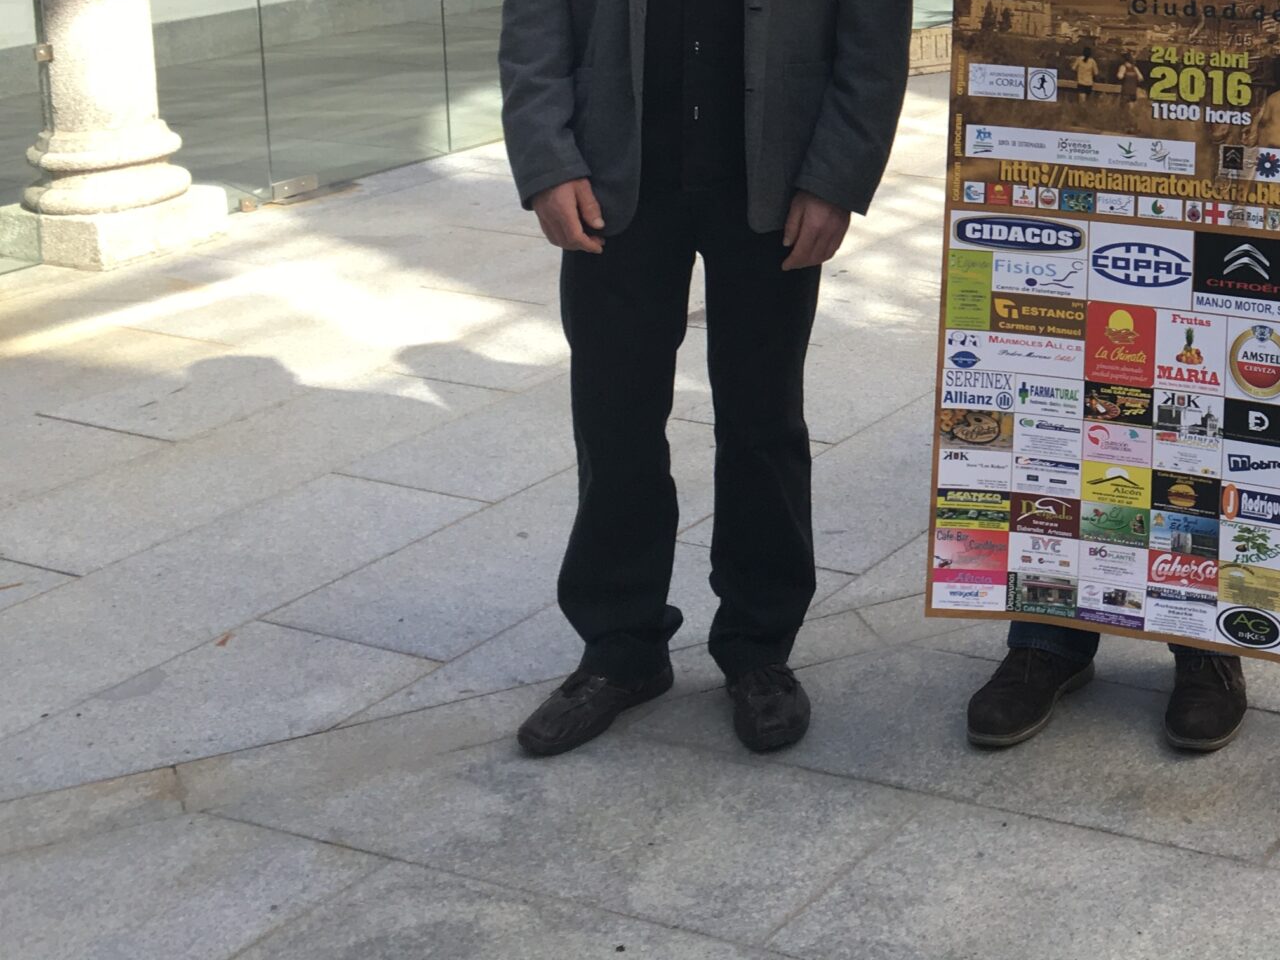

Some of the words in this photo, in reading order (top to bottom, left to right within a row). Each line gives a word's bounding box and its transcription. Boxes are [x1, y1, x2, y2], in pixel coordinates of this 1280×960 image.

[1151, 46, 1178, 65] 24
[1183, 49, 1205, 66] de
[1210, 51, 1249, 68] abril
[995, 78, 1025, 88] CORIA
[1149, 66, 1253, 106] 2016
[1151, 102, 1200, 120] 11:00
[1206, 106, 1252, 125] horas
[965, 223, 1074, 246] CIDACOS
[994, 259, 1057, 277] FisioS
[1092, 255, 1192, 276] COPAL
[1022, 306, 1084, 321] ESTANCO
[1196, 296, 1232, 309] MANJO
[1235, 301, 1275, 316] MOTOR,
[999, 321, 1036, 332] Carmen
[1038, 325, 1045, 334] y
[1047, 325, 1082, 336] Manuel
[1171, 313, 1212, 327] Frutas
[1095, 347, 1109, 359] La
[1111, 347, 1147, 364] Chinata
[1157, 365, 1220, 386] MARÍA
[1243, 365, 1277, 375] CERVEZA
[945, 370, 1012, 390] SERFINEX
[943, 390, 993, 406] Allianz
[1030, 385, 1079, 401] FARMATURAL
[1113, 487, 1142, 496] Alcón
[1007, 573, 1016, 610] Desayunos
[1232, 613, 1271, 634] AG
